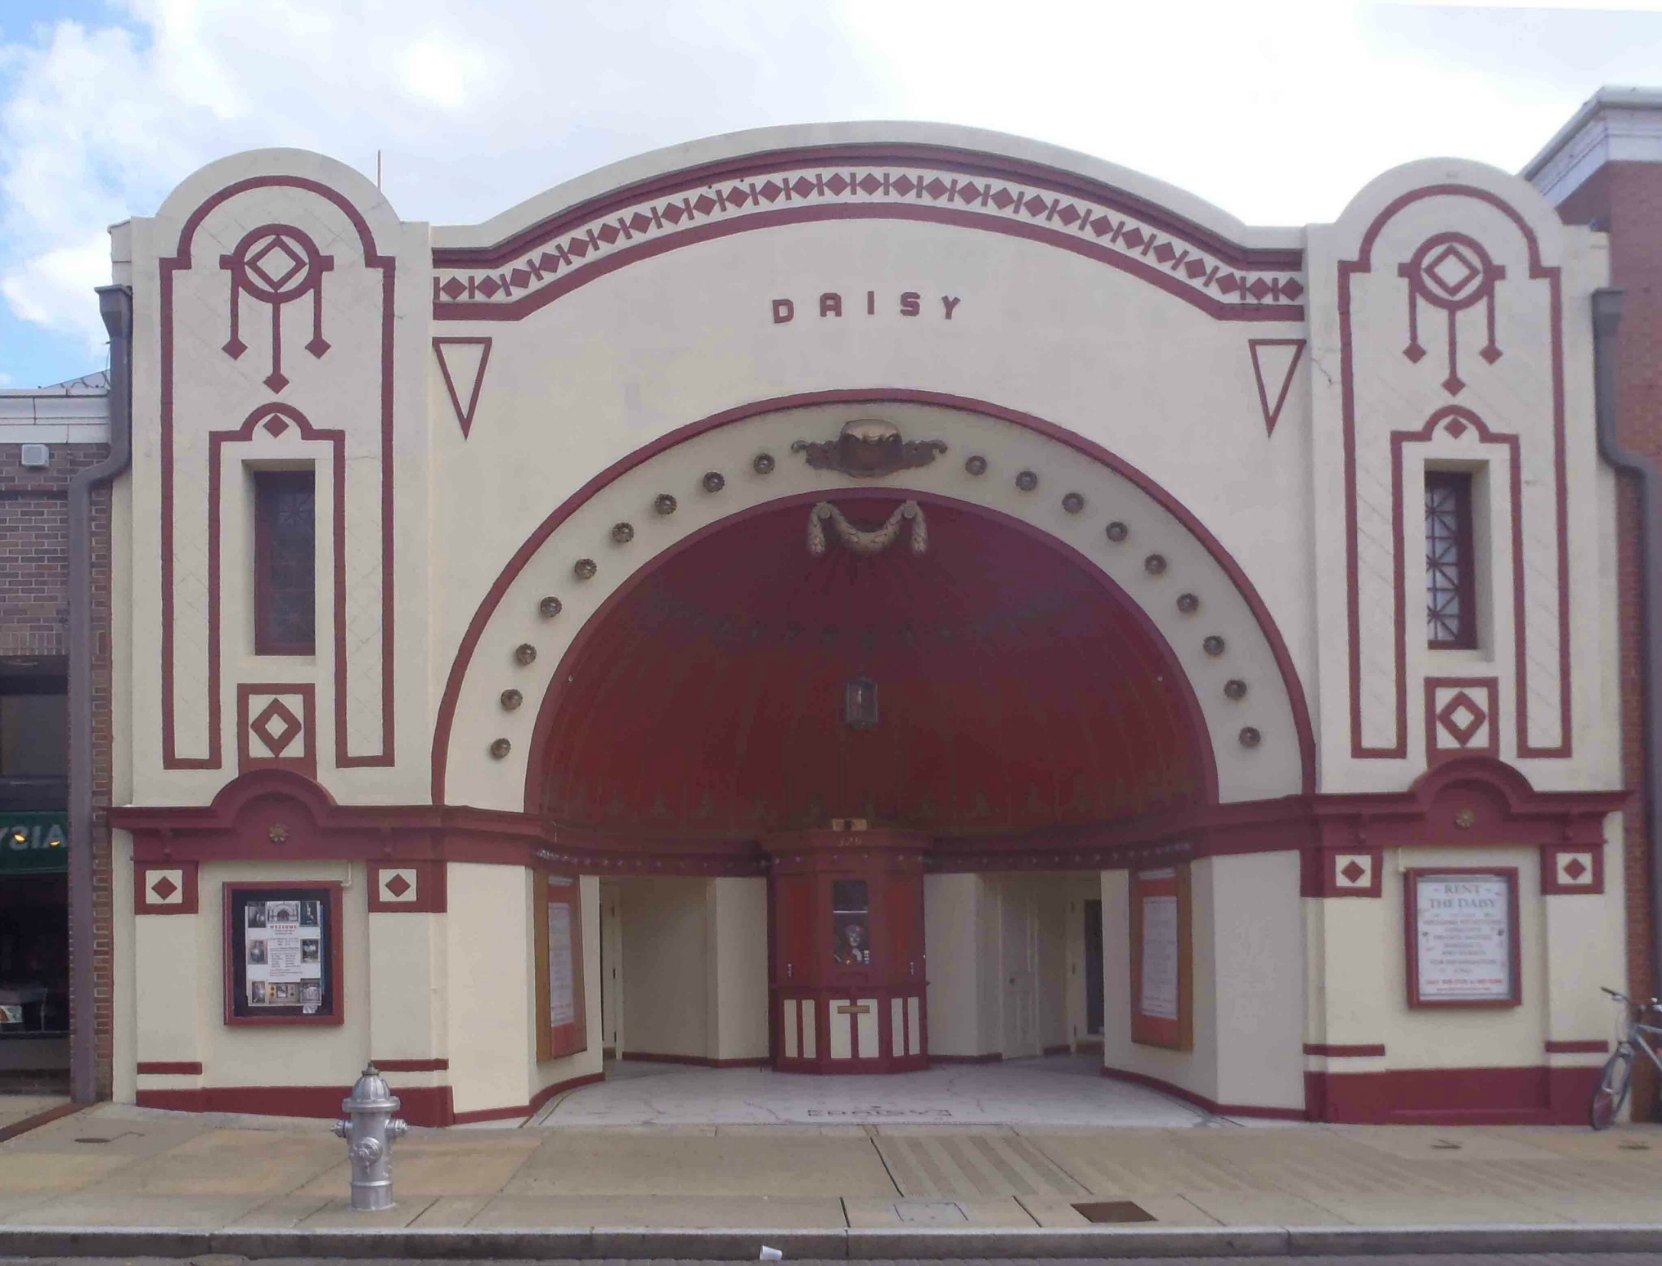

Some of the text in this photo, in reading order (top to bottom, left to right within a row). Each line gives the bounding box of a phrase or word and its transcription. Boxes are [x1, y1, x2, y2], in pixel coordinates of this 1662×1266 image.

[772, 290, 961, 324] DAISY
[1444, 883, 1480, 894] RENT
[1429, 898, 1495, 908] THE DAISY
